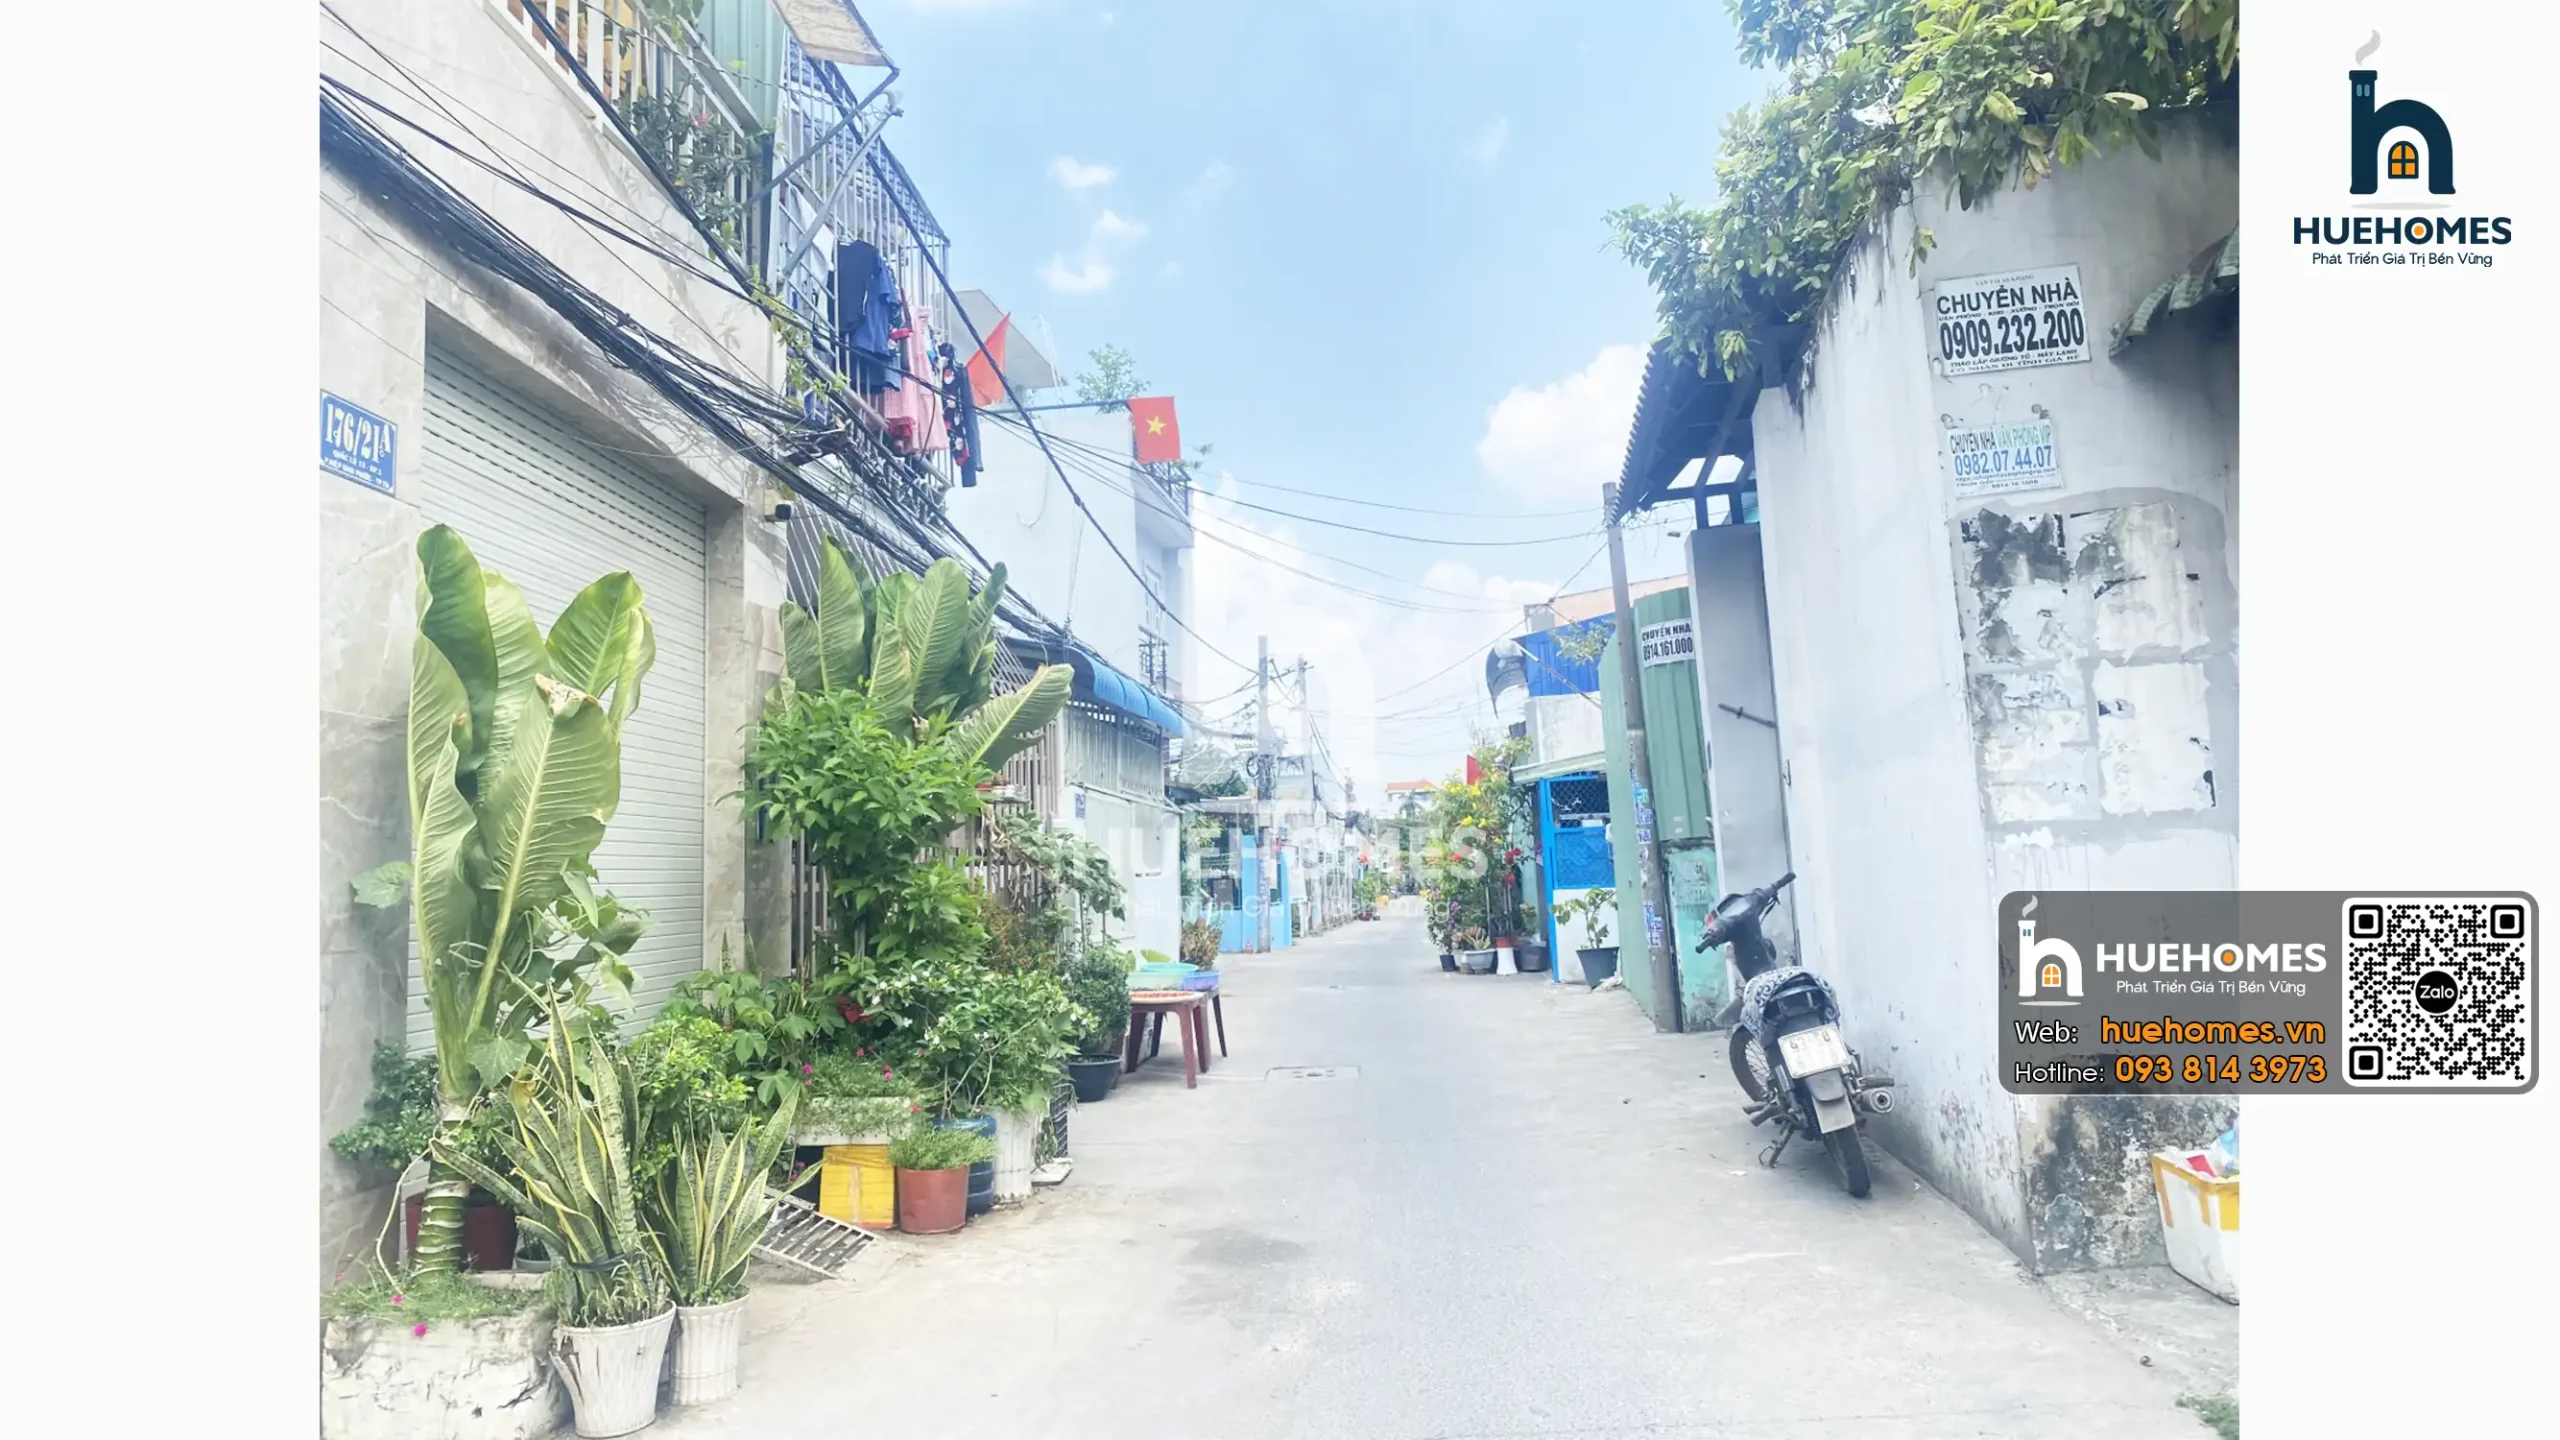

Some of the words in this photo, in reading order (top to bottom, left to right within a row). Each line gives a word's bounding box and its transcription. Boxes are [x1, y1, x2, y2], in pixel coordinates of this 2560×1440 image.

[1936, 285, 2025, 315] CHUYỂN
[2032, 277, 2079, 305] NHÀ
[1940, 307, 2085, 361] 0909.232.200
[325, 403, 392, 464] 176/21A
[1954, 445, 2052, 476] 0982.07.44.07
